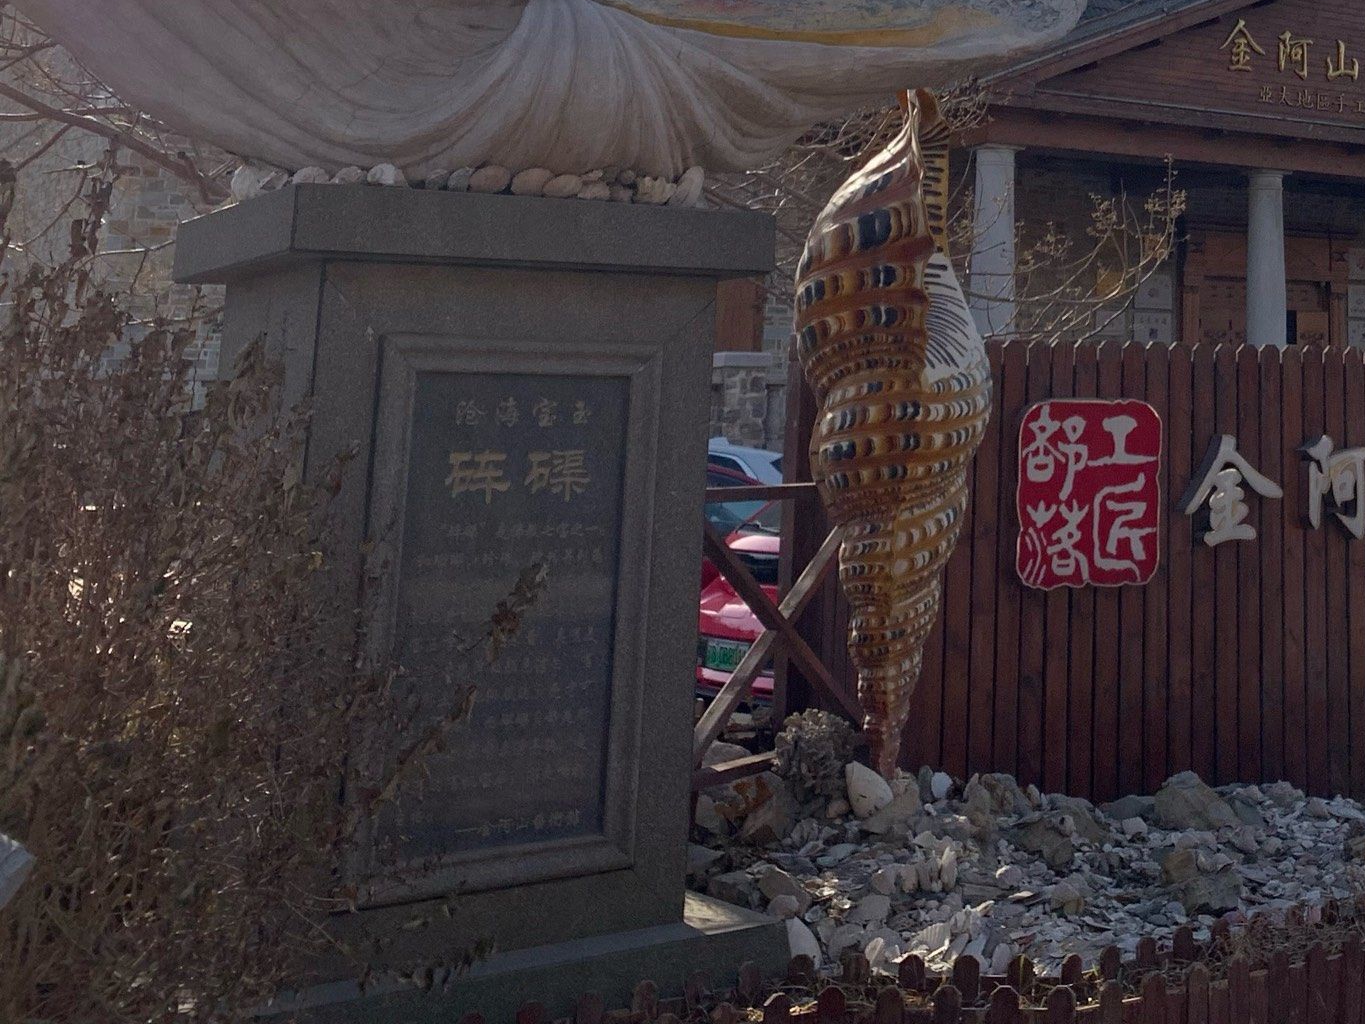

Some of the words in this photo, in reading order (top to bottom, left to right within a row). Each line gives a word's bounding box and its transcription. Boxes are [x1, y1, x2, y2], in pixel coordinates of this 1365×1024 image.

[1219, 18, 1360, 82] 金阿山
[445, 449, 592, 504] 砗磲
